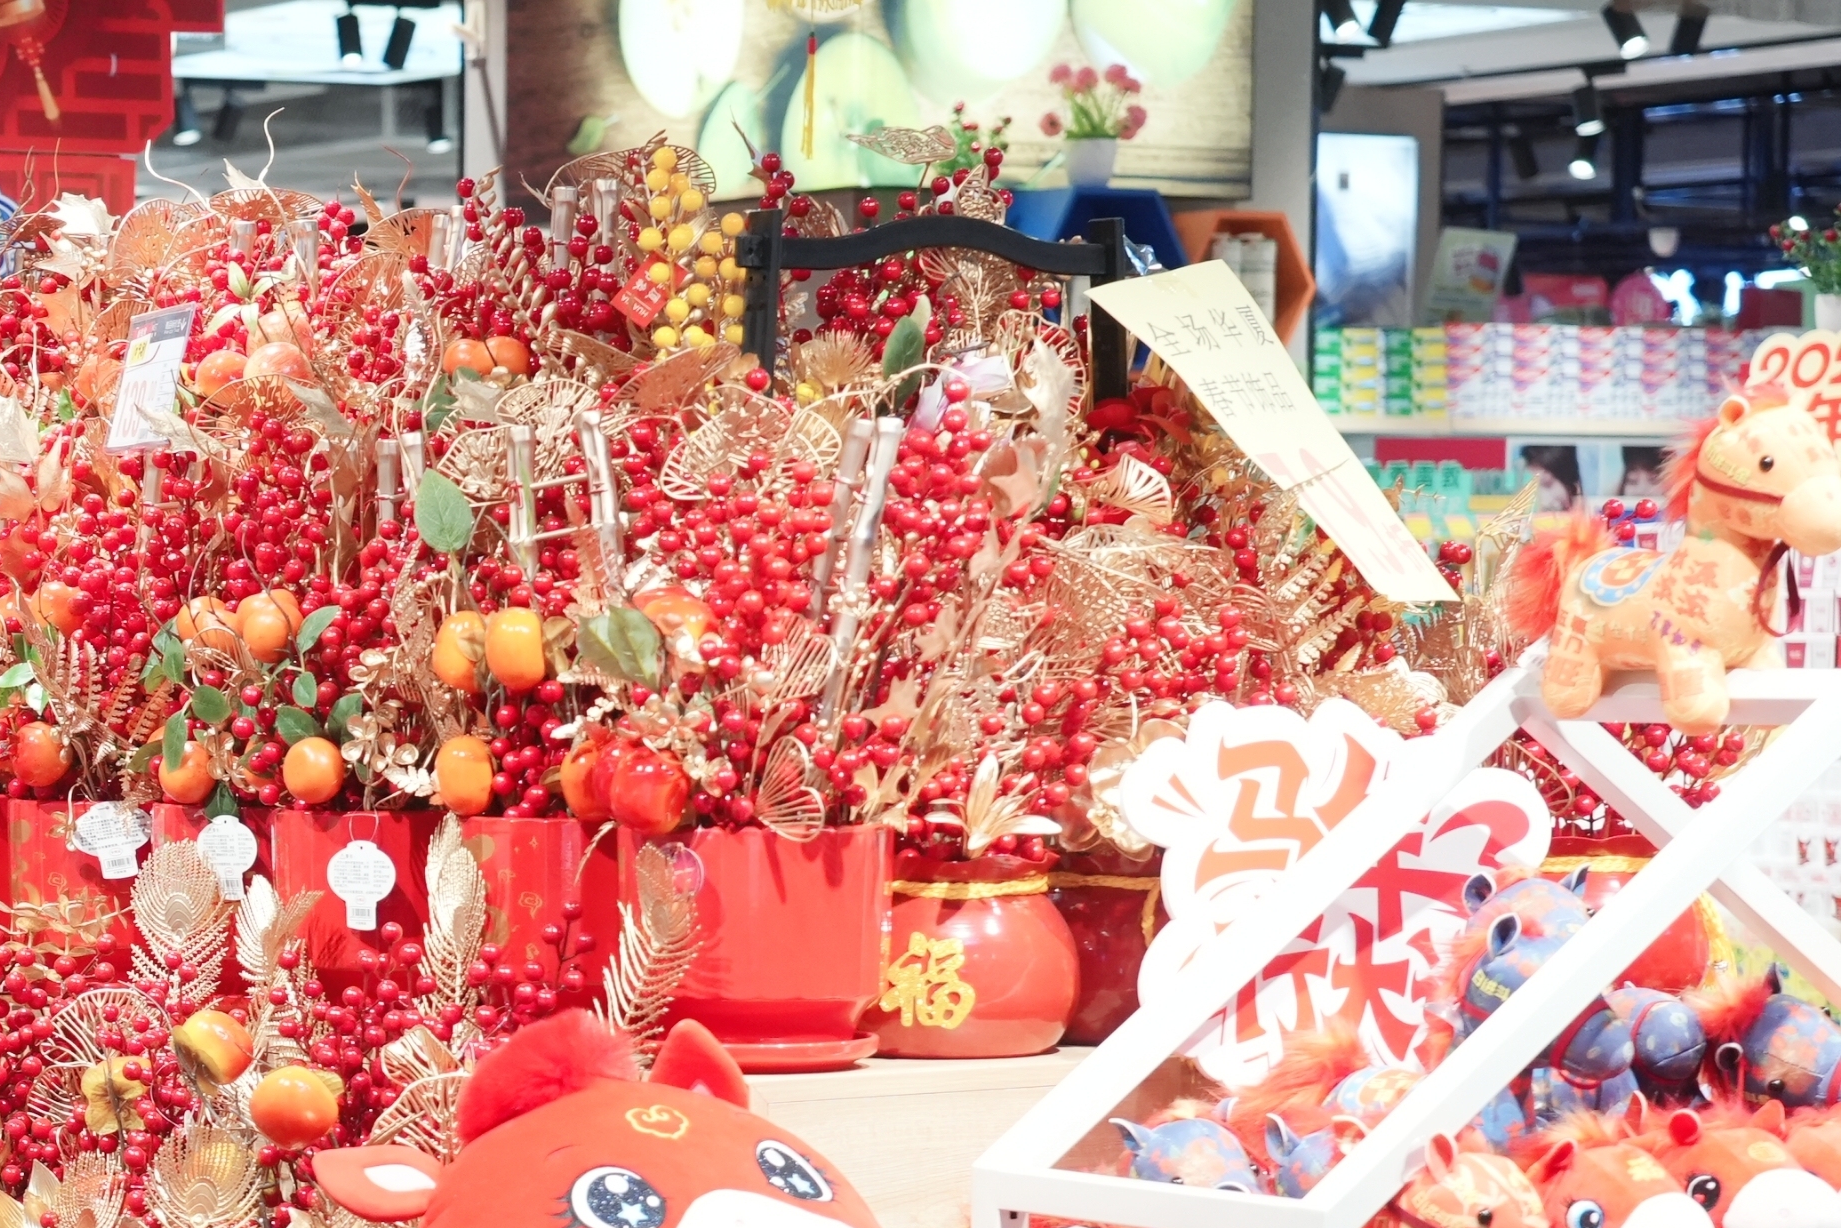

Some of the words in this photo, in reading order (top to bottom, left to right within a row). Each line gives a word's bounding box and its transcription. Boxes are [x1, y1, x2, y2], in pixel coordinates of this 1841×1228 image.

[1146, 304, 1275, 357] 全场华厦
[878, 931, 977, 1030] 福
